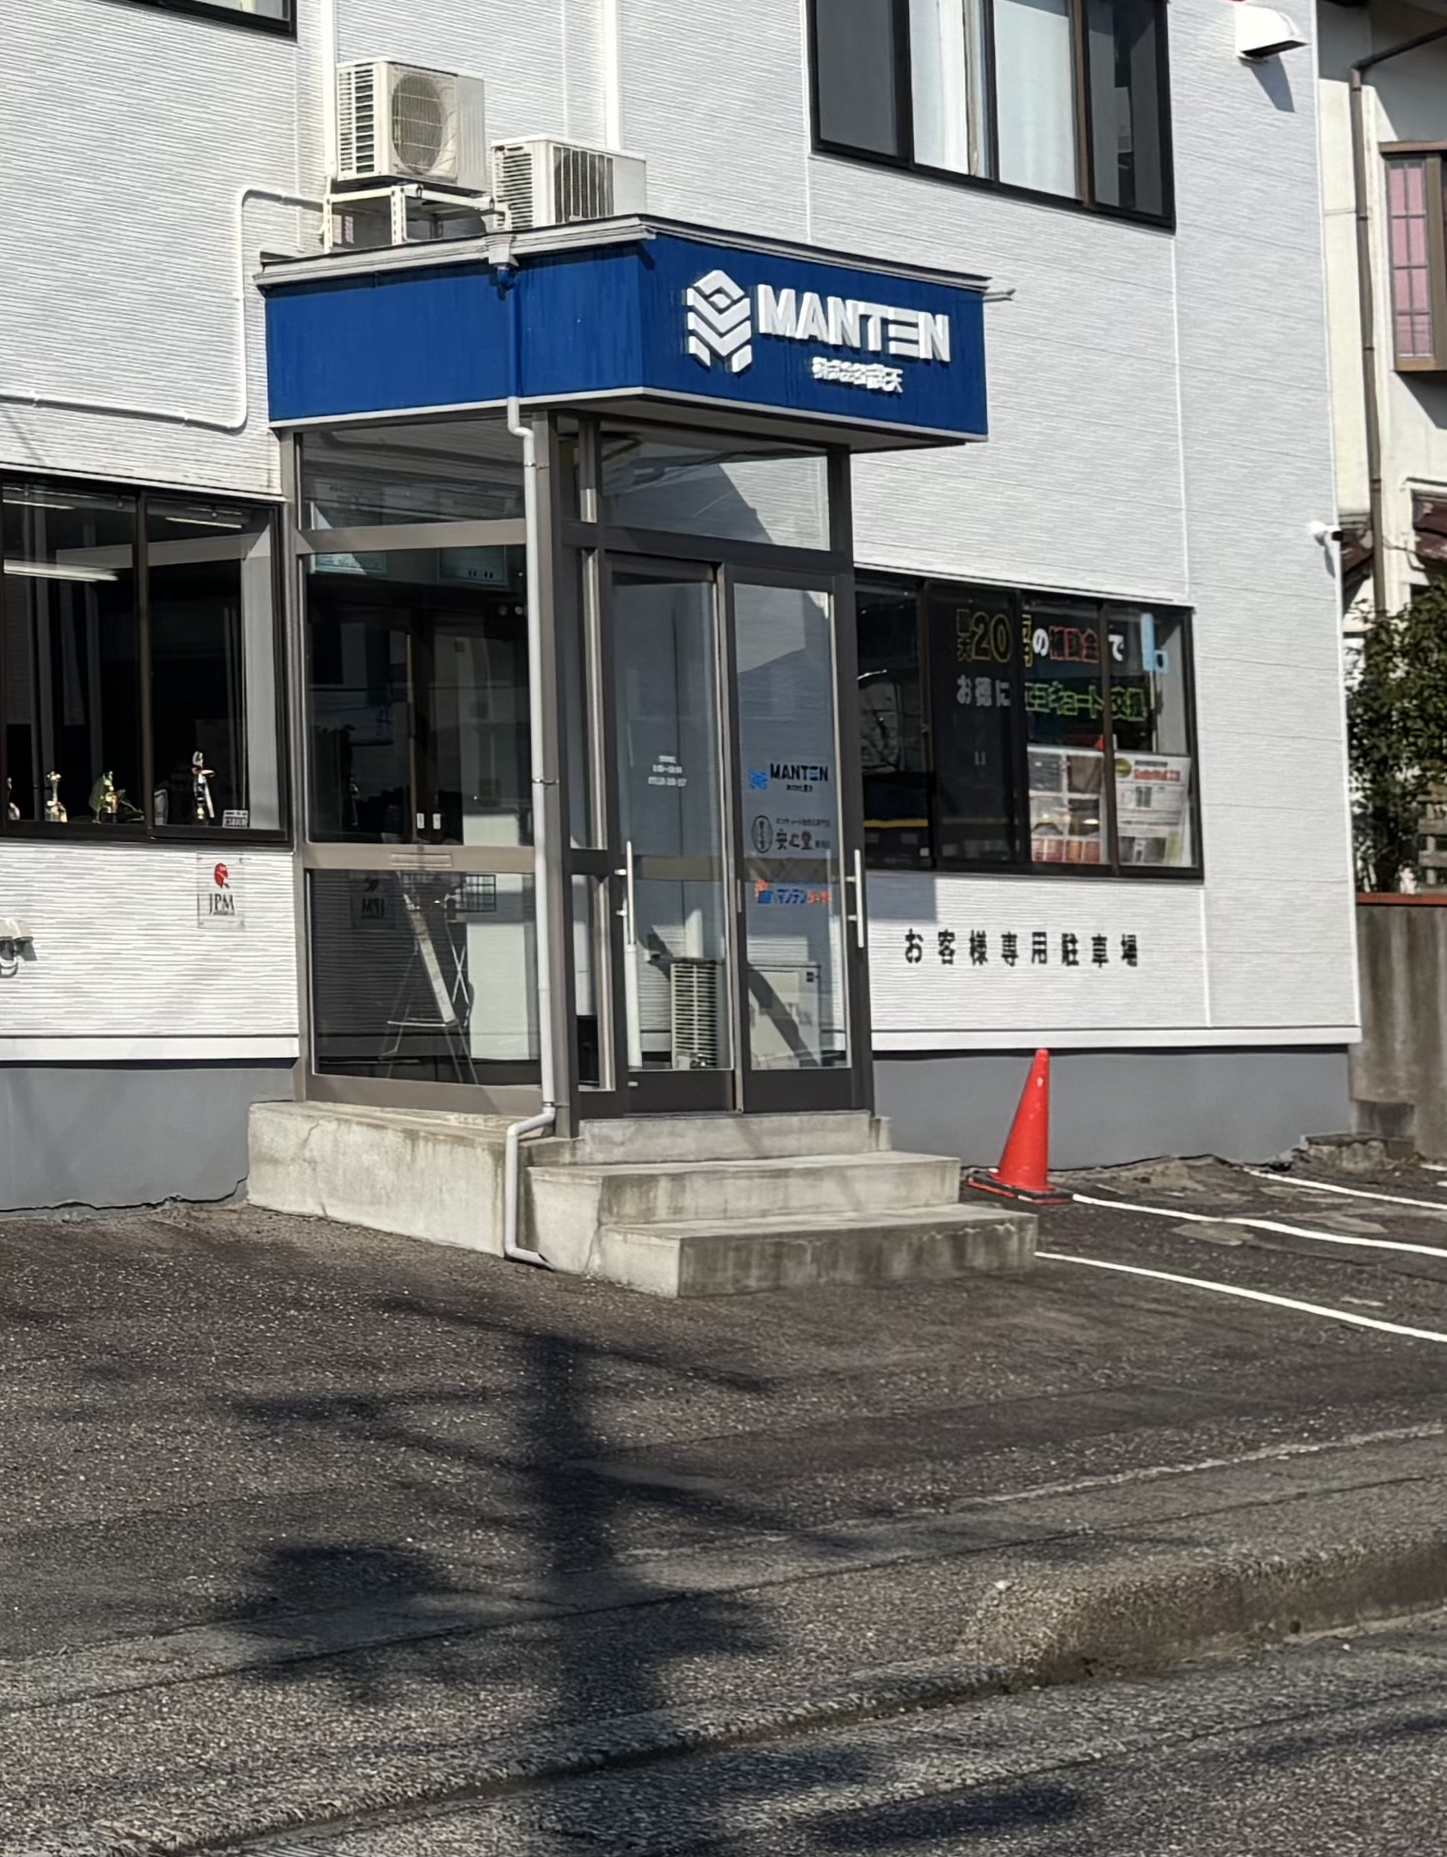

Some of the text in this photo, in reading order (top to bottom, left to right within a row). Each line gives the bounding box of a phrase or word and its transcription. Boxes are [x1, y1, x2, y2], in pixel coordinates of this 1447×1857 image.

[757, 283, 951, 363] MANTEN
[770, 763, 828, 781] MANTEN
[209, 893, 235, 915] JPM
[905, 928, 1138, 968] お客様専用駐車場
